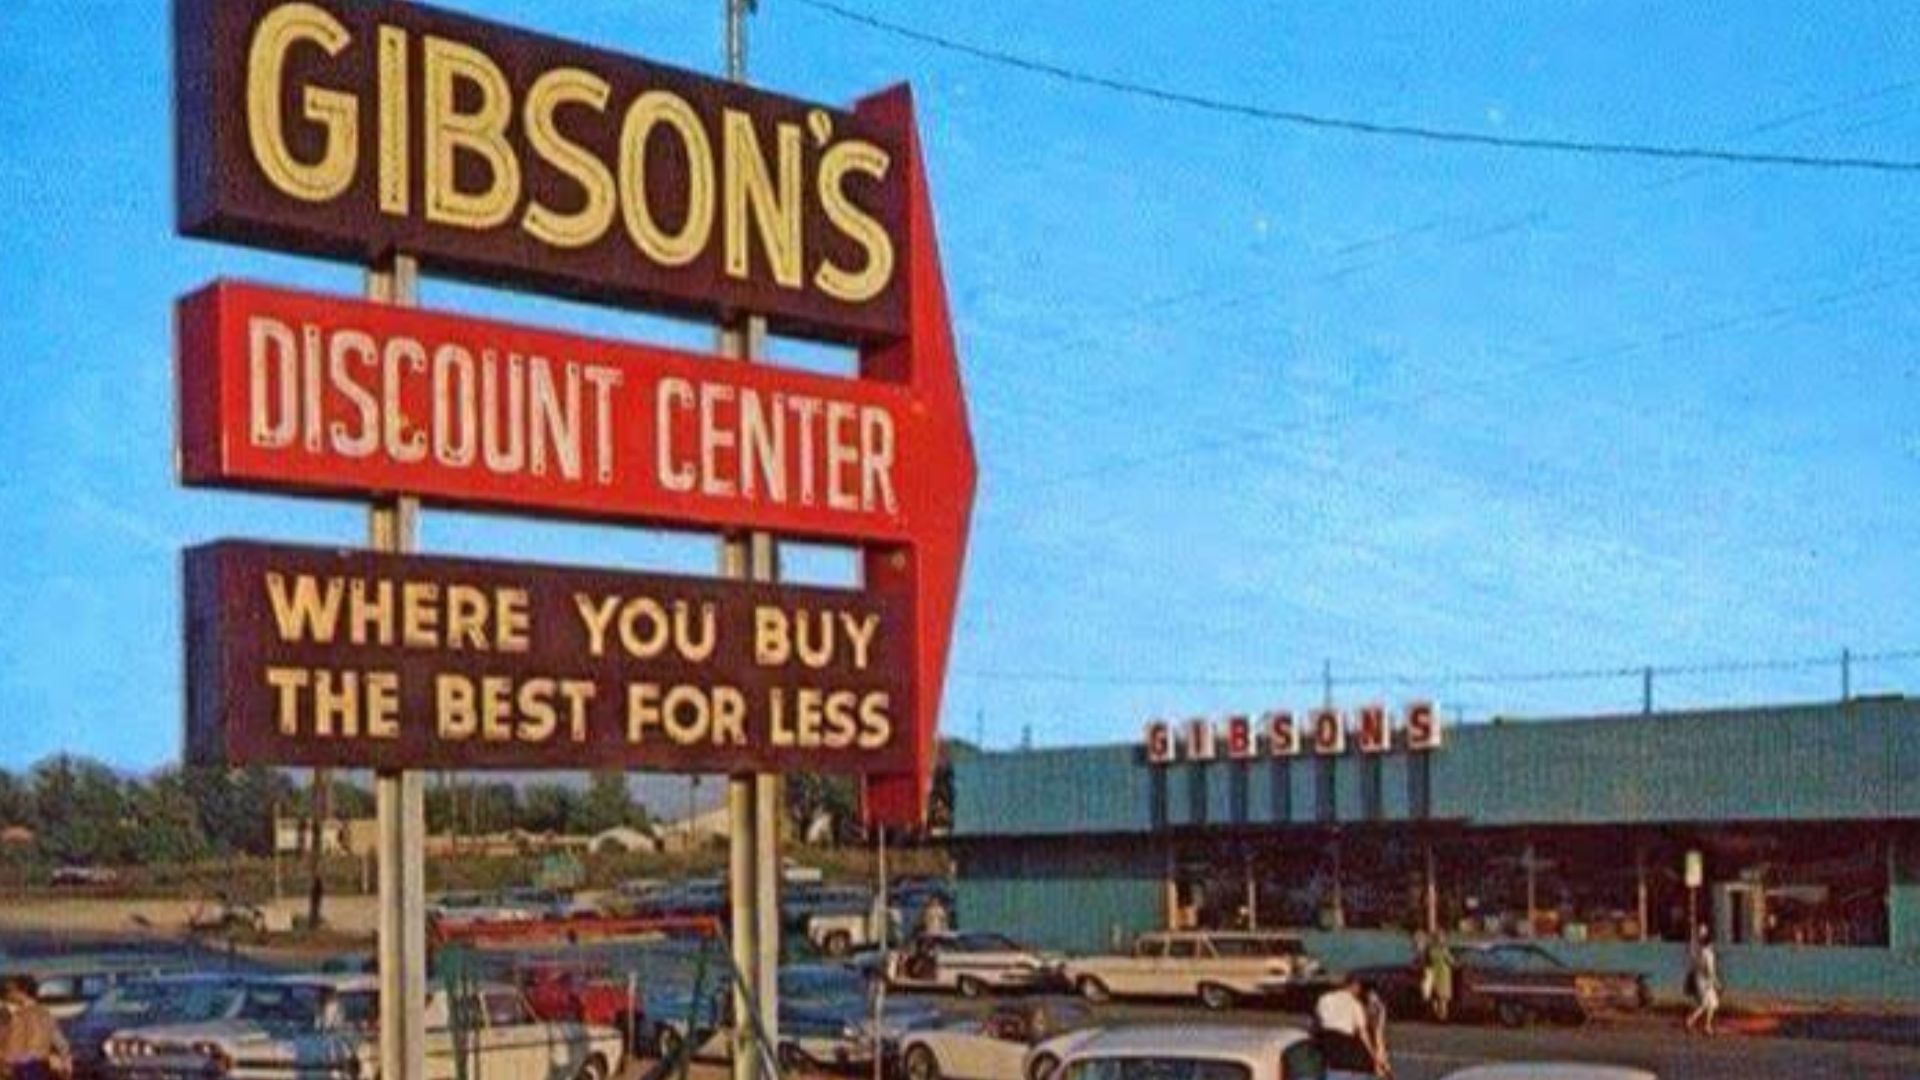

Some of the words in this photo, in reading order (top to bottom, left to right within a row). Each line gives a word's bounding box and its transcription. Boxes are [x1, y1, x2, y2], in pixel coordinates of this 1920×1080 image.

[247, 1, 894, 302] GIBSON'S
[247, 316, 623, 484] DISCOUNT
[656, 377, 898, 515] CENTER
[267, 572, 531, 652] WHERE
[575, 592, 716, 663] YOU
[755, 607, 881, 669] BUY
[267, 668, 400, 739] THE
[437, 676, 595, 744] BEST
[627, 683, 747, 746] FOR
[770, 687, 890, 749] LESS
[1148, 702, 1433, 758] GIBSONS
